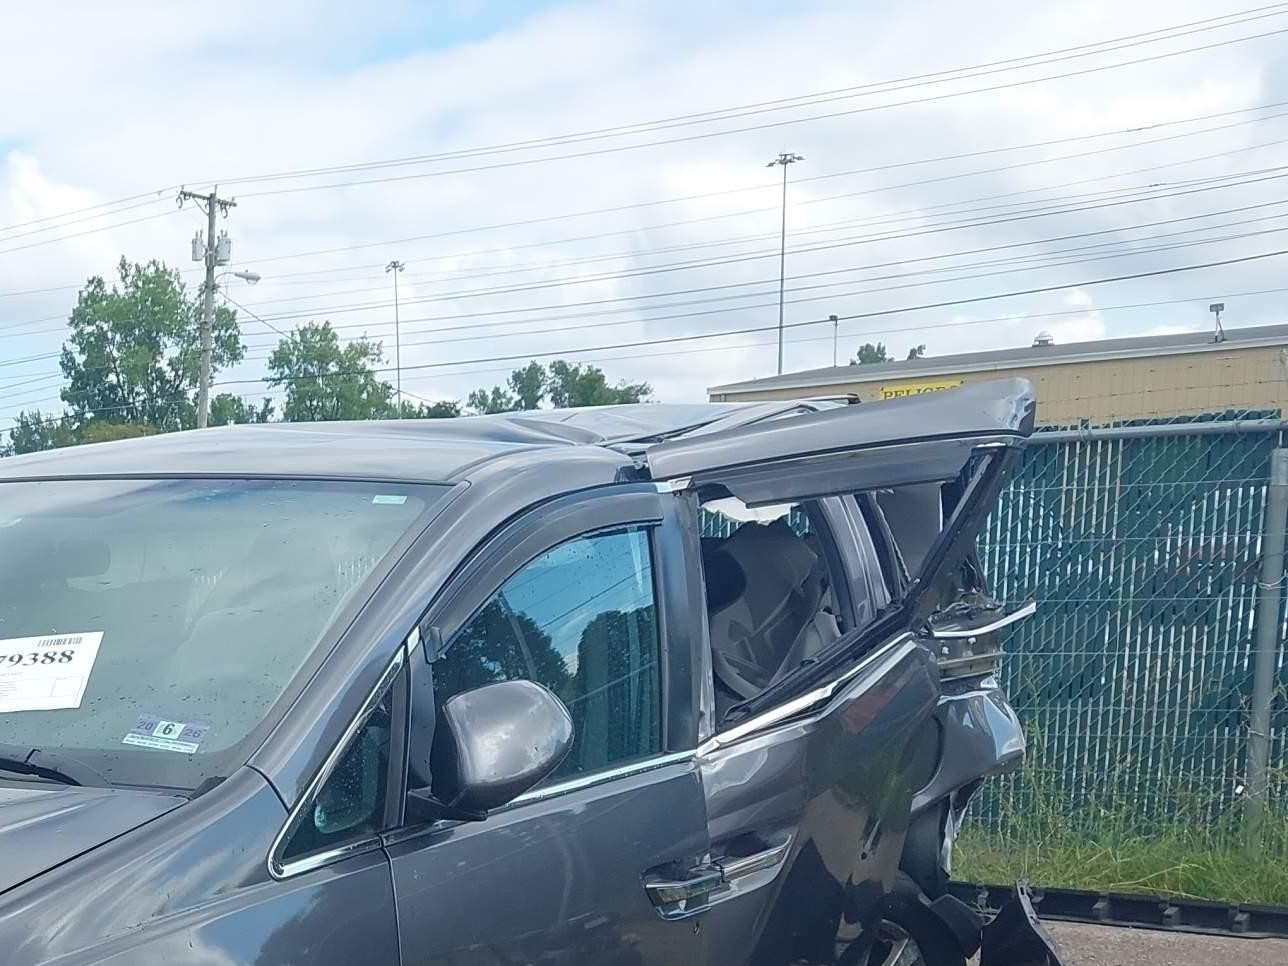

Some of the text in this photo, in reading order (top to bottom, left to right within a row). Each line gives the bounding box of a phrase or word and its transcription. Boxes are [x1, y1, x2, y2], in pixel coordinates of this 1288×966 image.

[136, 720, 202, 738] 20 6 26
